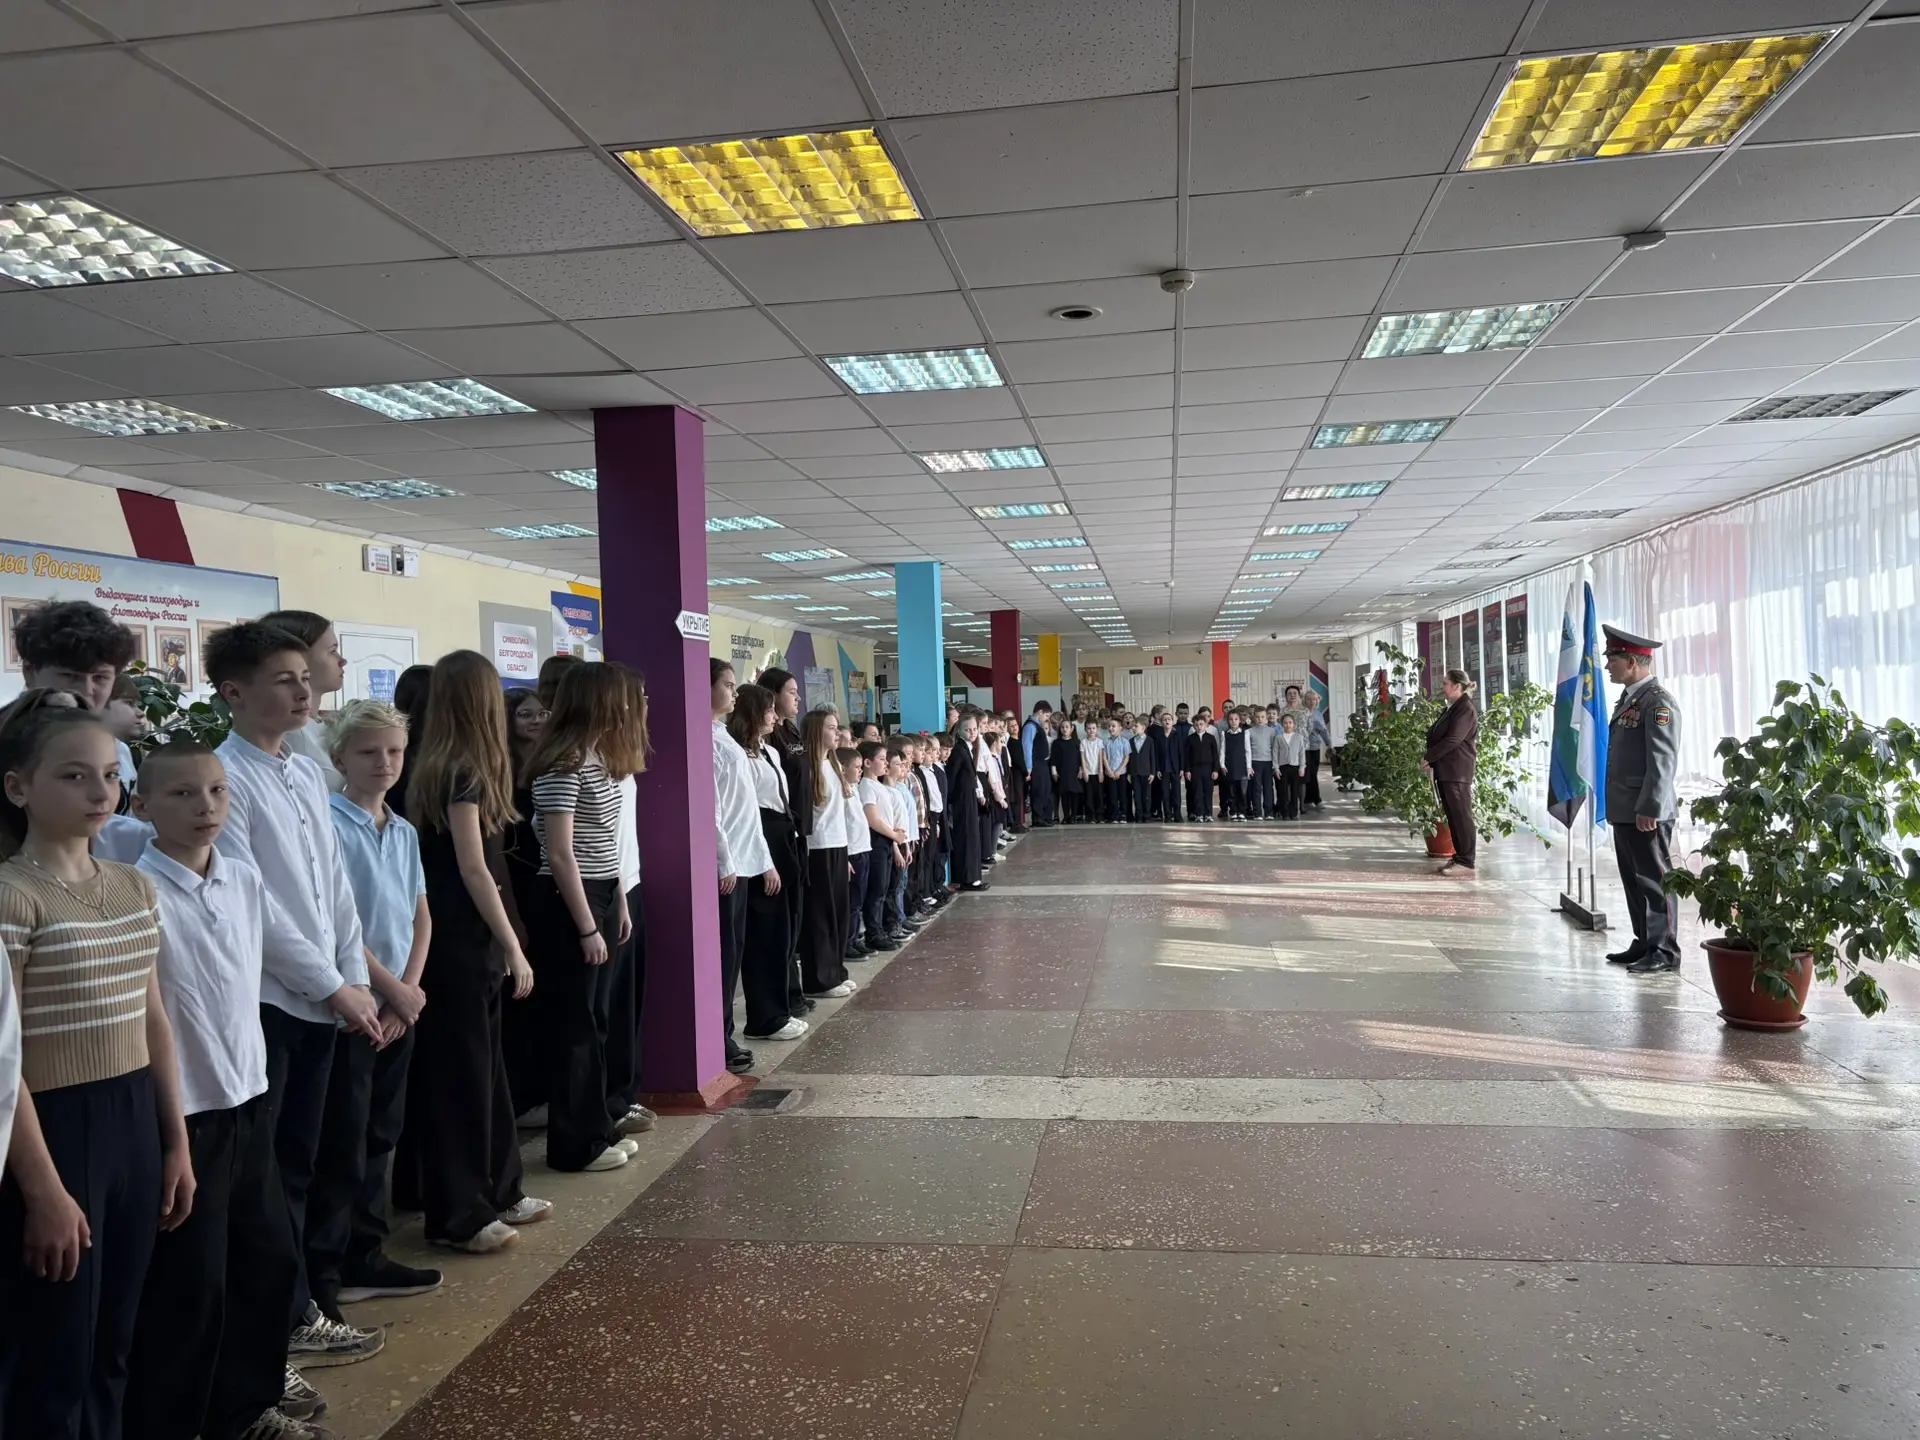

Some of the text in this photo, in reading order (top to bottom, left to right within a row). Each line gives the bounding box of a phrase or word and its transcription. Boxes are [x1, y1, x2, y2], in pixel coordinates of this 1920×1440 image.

[32, 552, 101, 583] России
[95, 587, 147, 603] Выдающиеся
[149, 594, 193, 608] полководцы
[111, 604, 187, 621] флотоводцы России
[682, 614, 709, 632] УКРЫТИЕ
[502, 635, 529, 645] СИМВОЛИКА
[731, 634, 764, 648] БЕЛГОРОДСКАЯ
[499, 649, 533, 659] БЕЛГОРОДСКОЙ
[731, 648, 752, 660] ОБЛАСТЬ
[507, 663, 527, 672] ОБЛАСТИ
